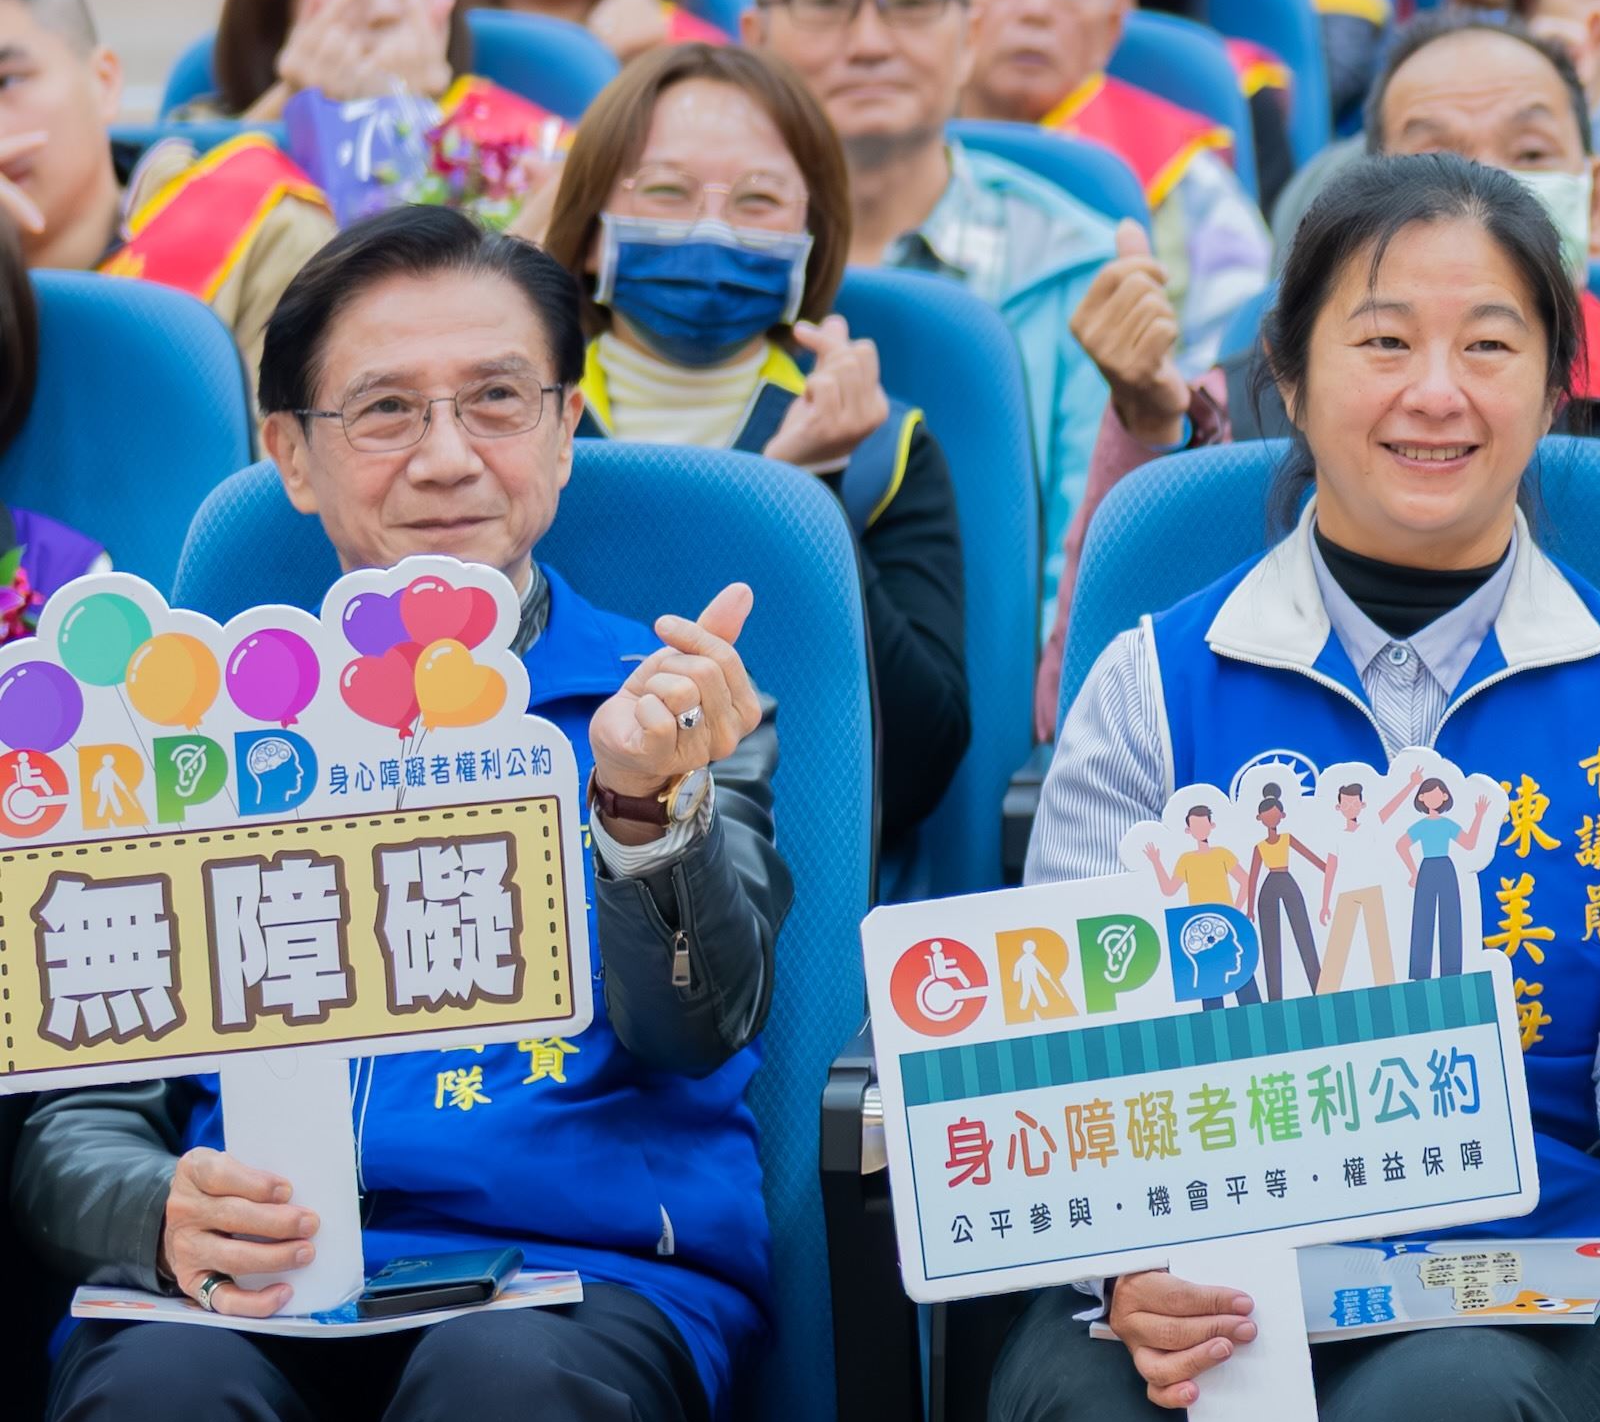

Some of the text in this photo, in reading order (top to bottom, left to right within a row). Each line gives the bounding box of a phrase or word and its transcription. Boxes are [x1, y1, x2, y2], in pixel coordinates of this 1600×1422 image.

[329, 744, 553, 795] 身心障礙者權利公約
[34, 835, 522, 1047] 無障礙
[889, 902, 1259, 1037] CRPD
[943, 1046, 1482, 1191] 身心障礙者權利公約
